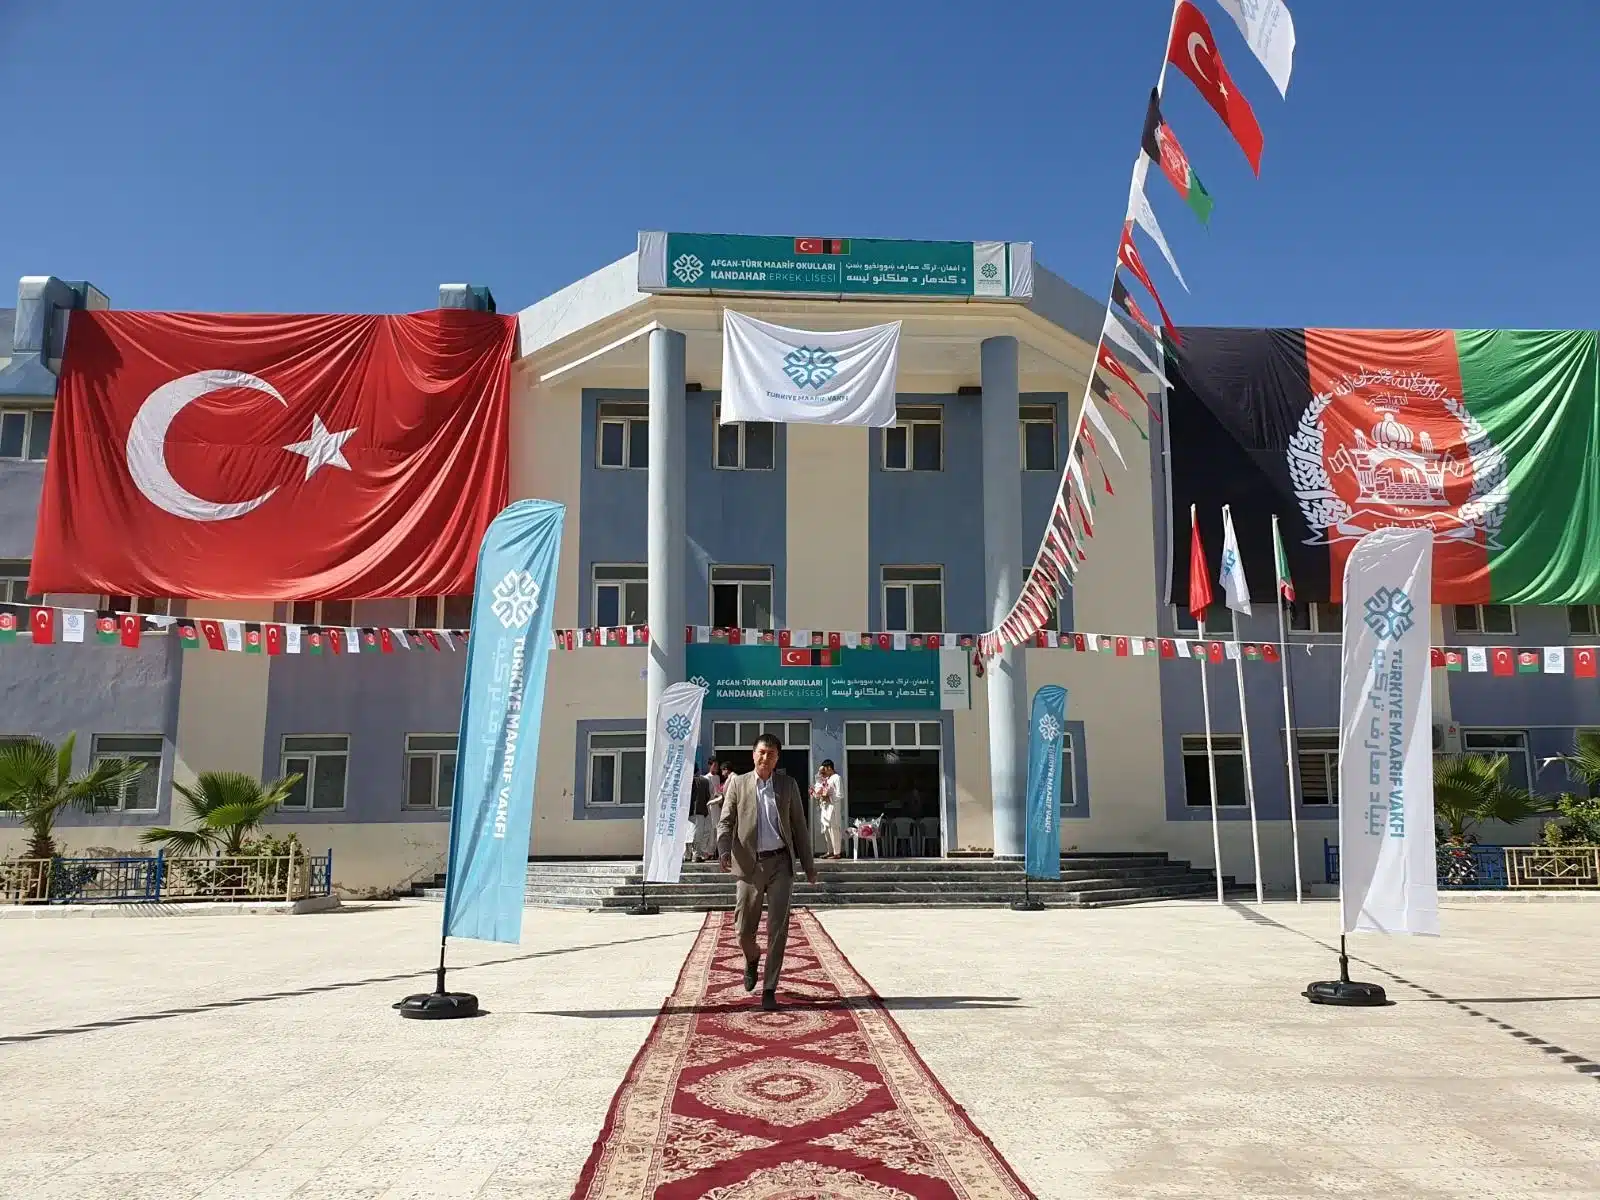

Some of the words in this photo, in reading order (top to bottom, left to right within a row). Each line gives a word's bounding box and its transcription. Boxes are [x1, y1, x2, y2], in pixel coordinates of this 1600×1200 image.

[710, 270, 766, 281] KANDAHAR
[769, 272, 802, 282] ERKEK
[711, 259, 763, 268] AFGAN-TÜRK
[763, 260, 795, 269] MAARİF
[796, 263, 836, 271] OKULLARI
[896, 264, 920, 272] معارف
[716, 678, 761, 686] AFGAN-TÜRK
[761, 678, 788, 686] MAARİF
[716, 689, 764, 698] KANDAHAR
[1367, 648, 1389, 711] ترکیه
[1388, 648, 1404, 719] TÜRKİYE
[1364, 716, 1388, 786] معارف
[1388, 722, 1404, 787] MAARİF
[493, 787, 511, 840] VAKFI
[1388, 789, 1405, 838] VAKFI
